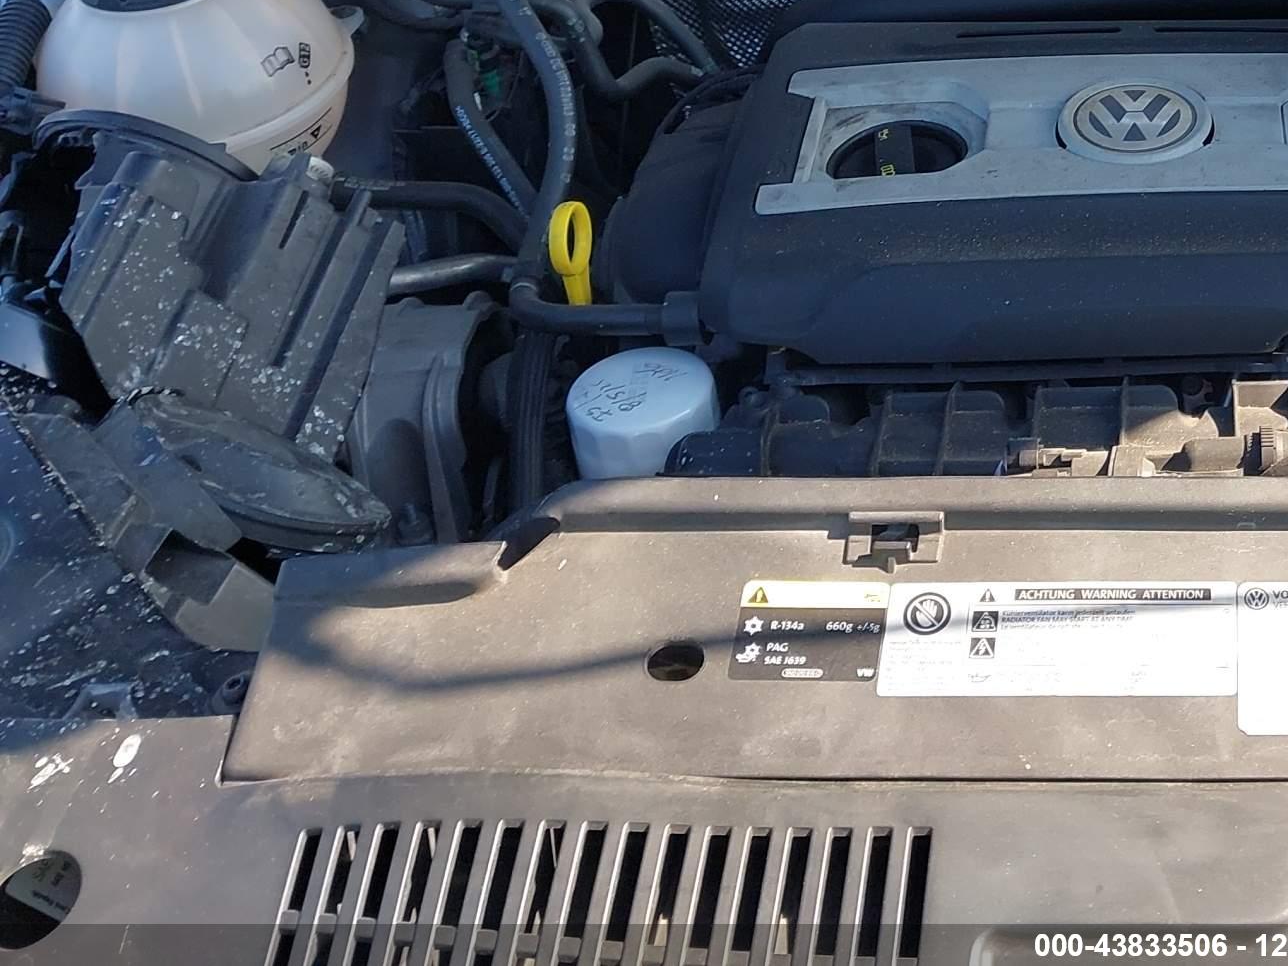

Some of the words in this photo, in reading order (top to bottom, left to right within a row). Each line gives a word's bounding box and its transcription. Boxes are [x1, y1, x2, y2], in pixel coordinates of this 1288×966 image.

[1018, 589, 1076, 600] ACHTUNG
[1080, 589, 1137, 600] WARNING
[1142, 589, 1205, 600] ATTENTION
[770, 620, 805, 631] R-134a
[825, 621, 854, 633] 660g
[766, 642, 789, 652] PAG
[763, 655, 782, 665] SAE
[856, 668, 875, 677] VW
